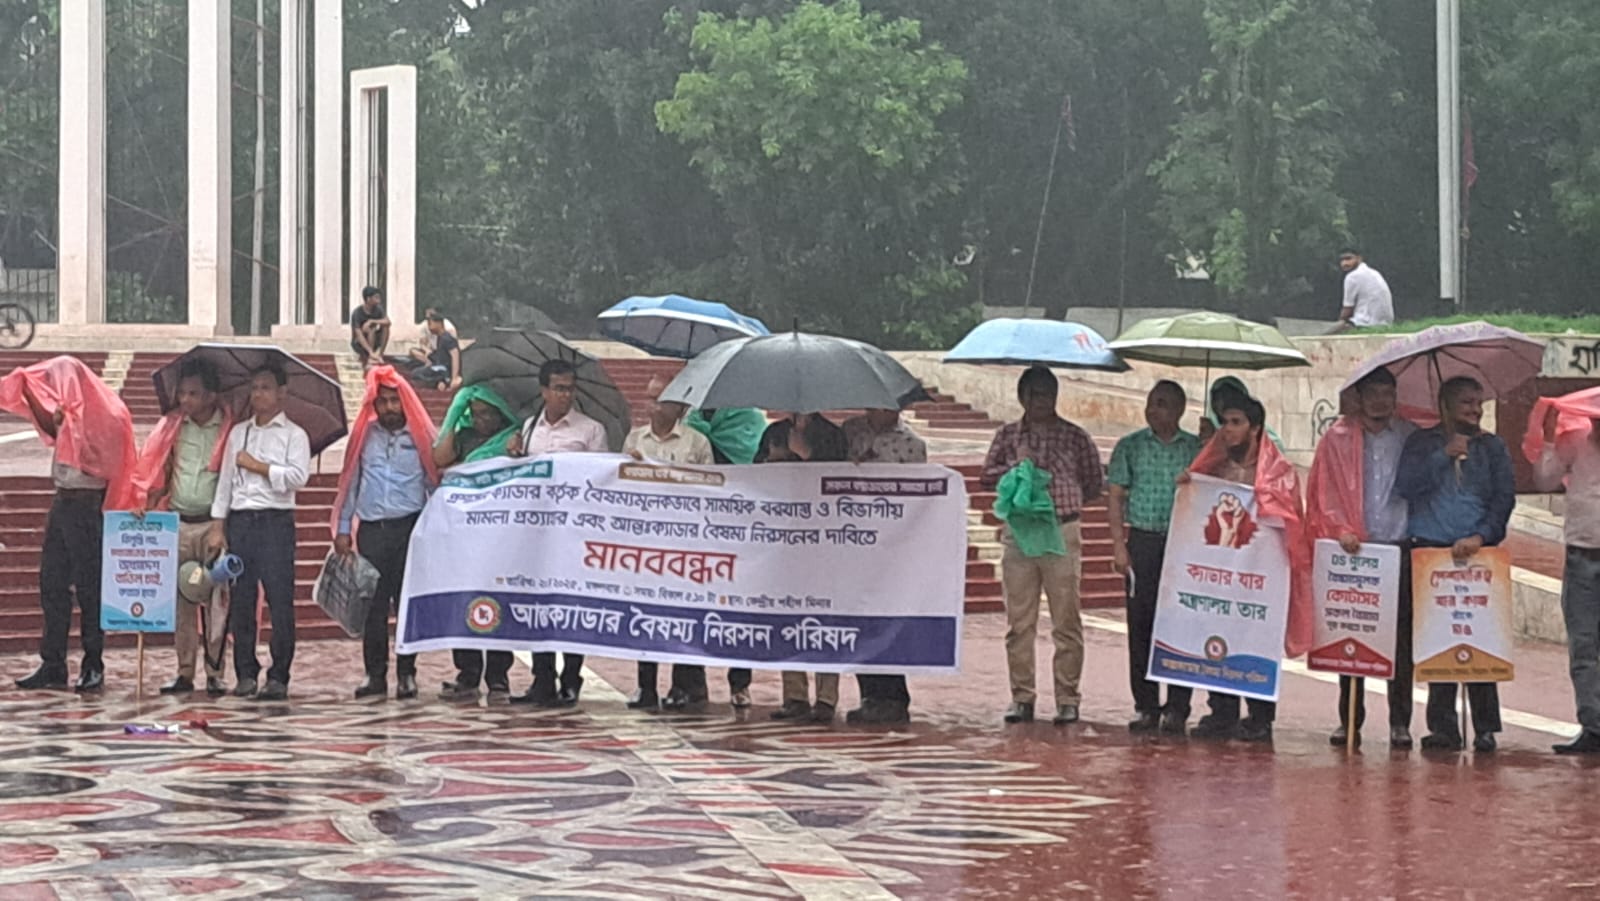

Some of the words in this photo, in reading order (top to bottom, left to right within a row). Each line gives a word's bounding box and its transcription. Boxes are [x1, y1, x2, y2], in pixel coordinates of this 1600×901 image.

[584, 480, 701, 512] বৈষম্যমূলকভাবে
[704, 493, 755, 515] সাময়িক
[816, 502, 830, 517] ও
[836, 496, 904, 518] বিভাগীয়
[466, 510, 510, 525] মামলা
[573, 513, 606, 532] এবং
[610, 516, 699, 538] আন্তঃক্যাডার
[703, 516, 746, 542] বৈষম্য
[750, 521, 820, 545] নিরসনের
[825, 523, 879, 545] দাবিতে
[584, 540, 736, 584] মানববন্ধন
[1186, 563, 1233, 586] ক্যাডার
[1238, 572, 1266, 590] যার
[629, 605, 697, 644] বৈষম্য
[704, 612, 771, 650] নিরসন
[780, 615, 860, 652] পরিষদ
[1236, 602, 1268, 621] তার
